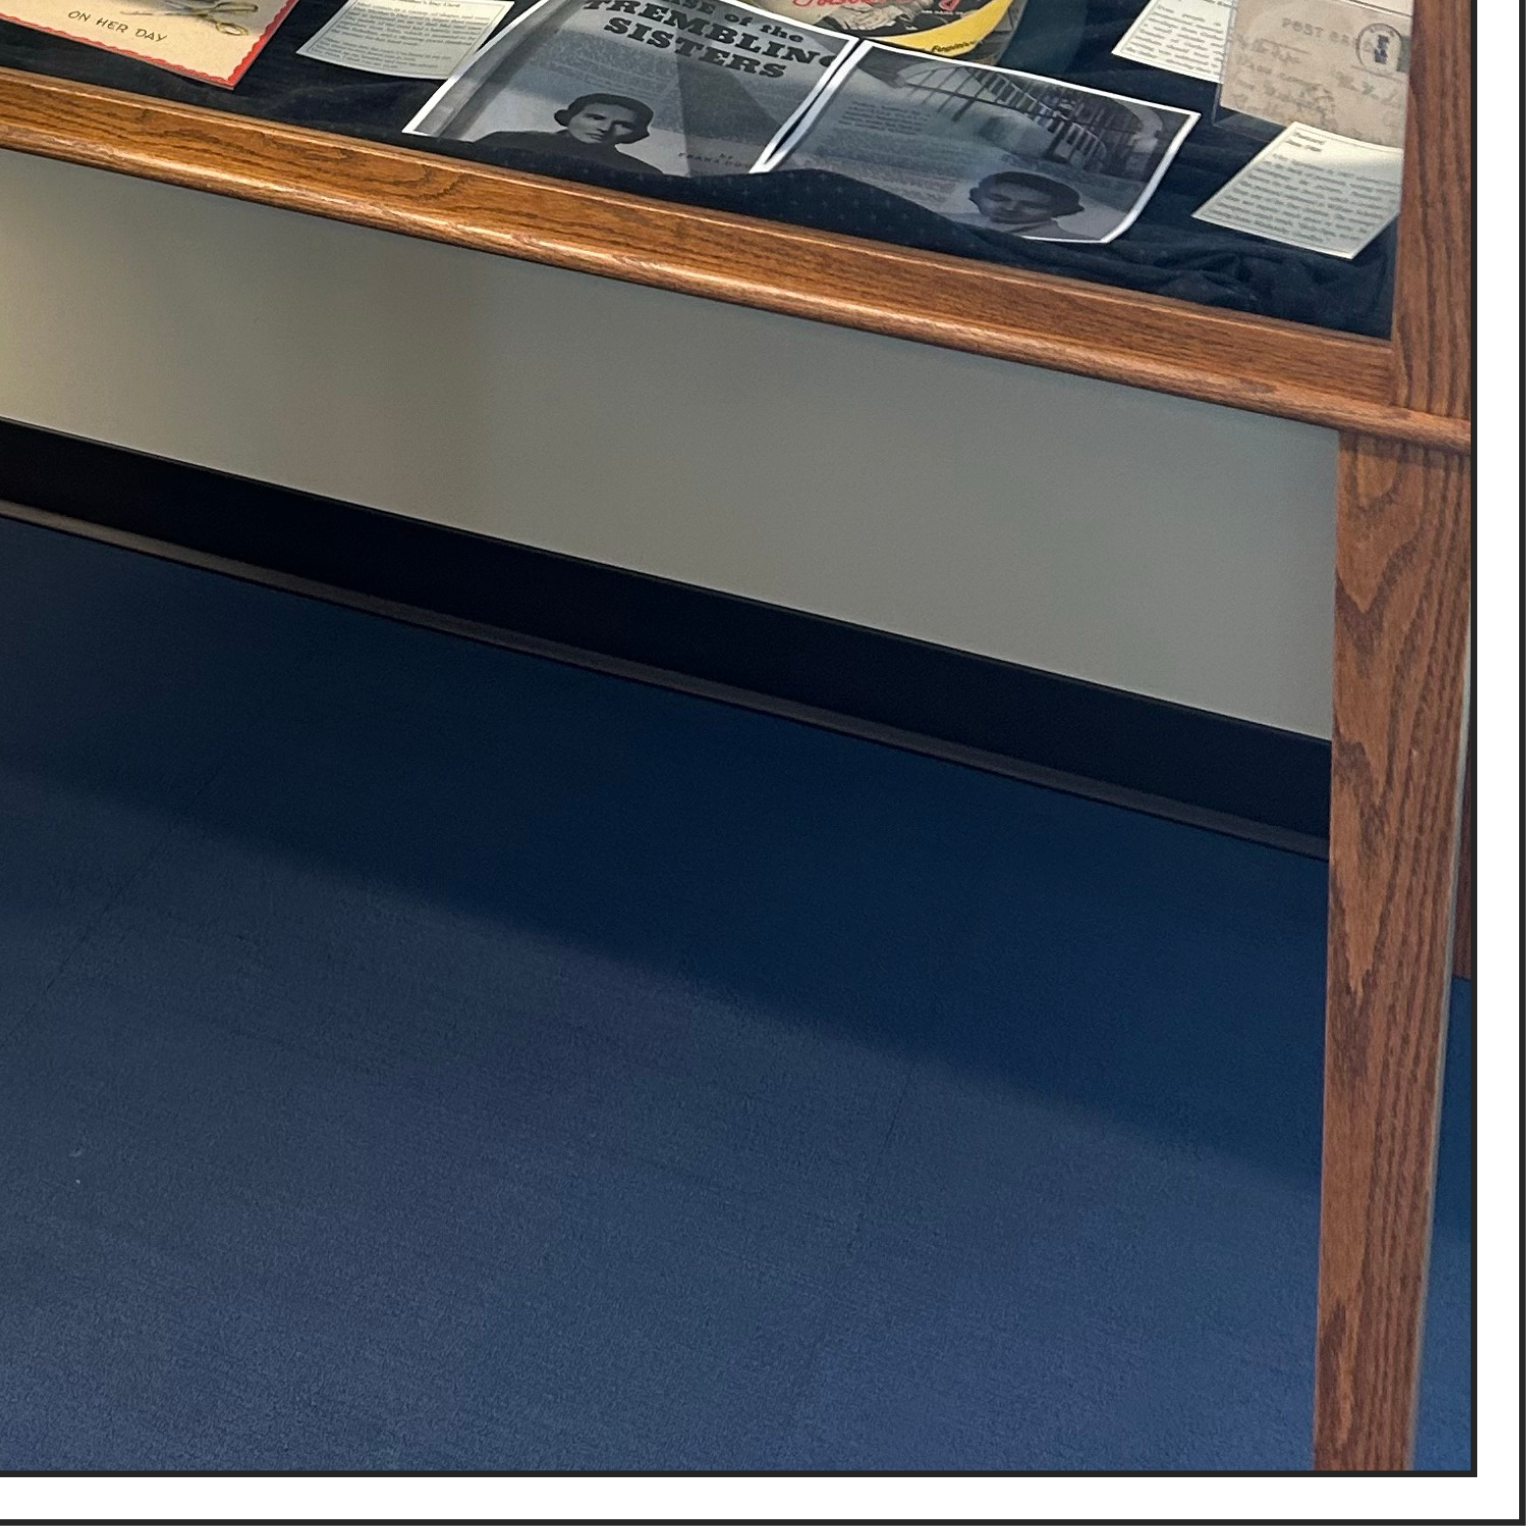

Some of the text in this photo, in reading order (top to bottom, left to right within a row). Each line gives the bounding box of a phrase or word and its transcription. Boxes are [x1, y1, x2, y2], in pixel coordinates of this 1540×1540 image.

[68, 10, 167, 42] ON HER DAY
[724, 12, 753, 27] of
[760, 24, 804, 43] the
[1282, 17, 1324, 38] POST
[603, 17, 787, 79] SISTERS
